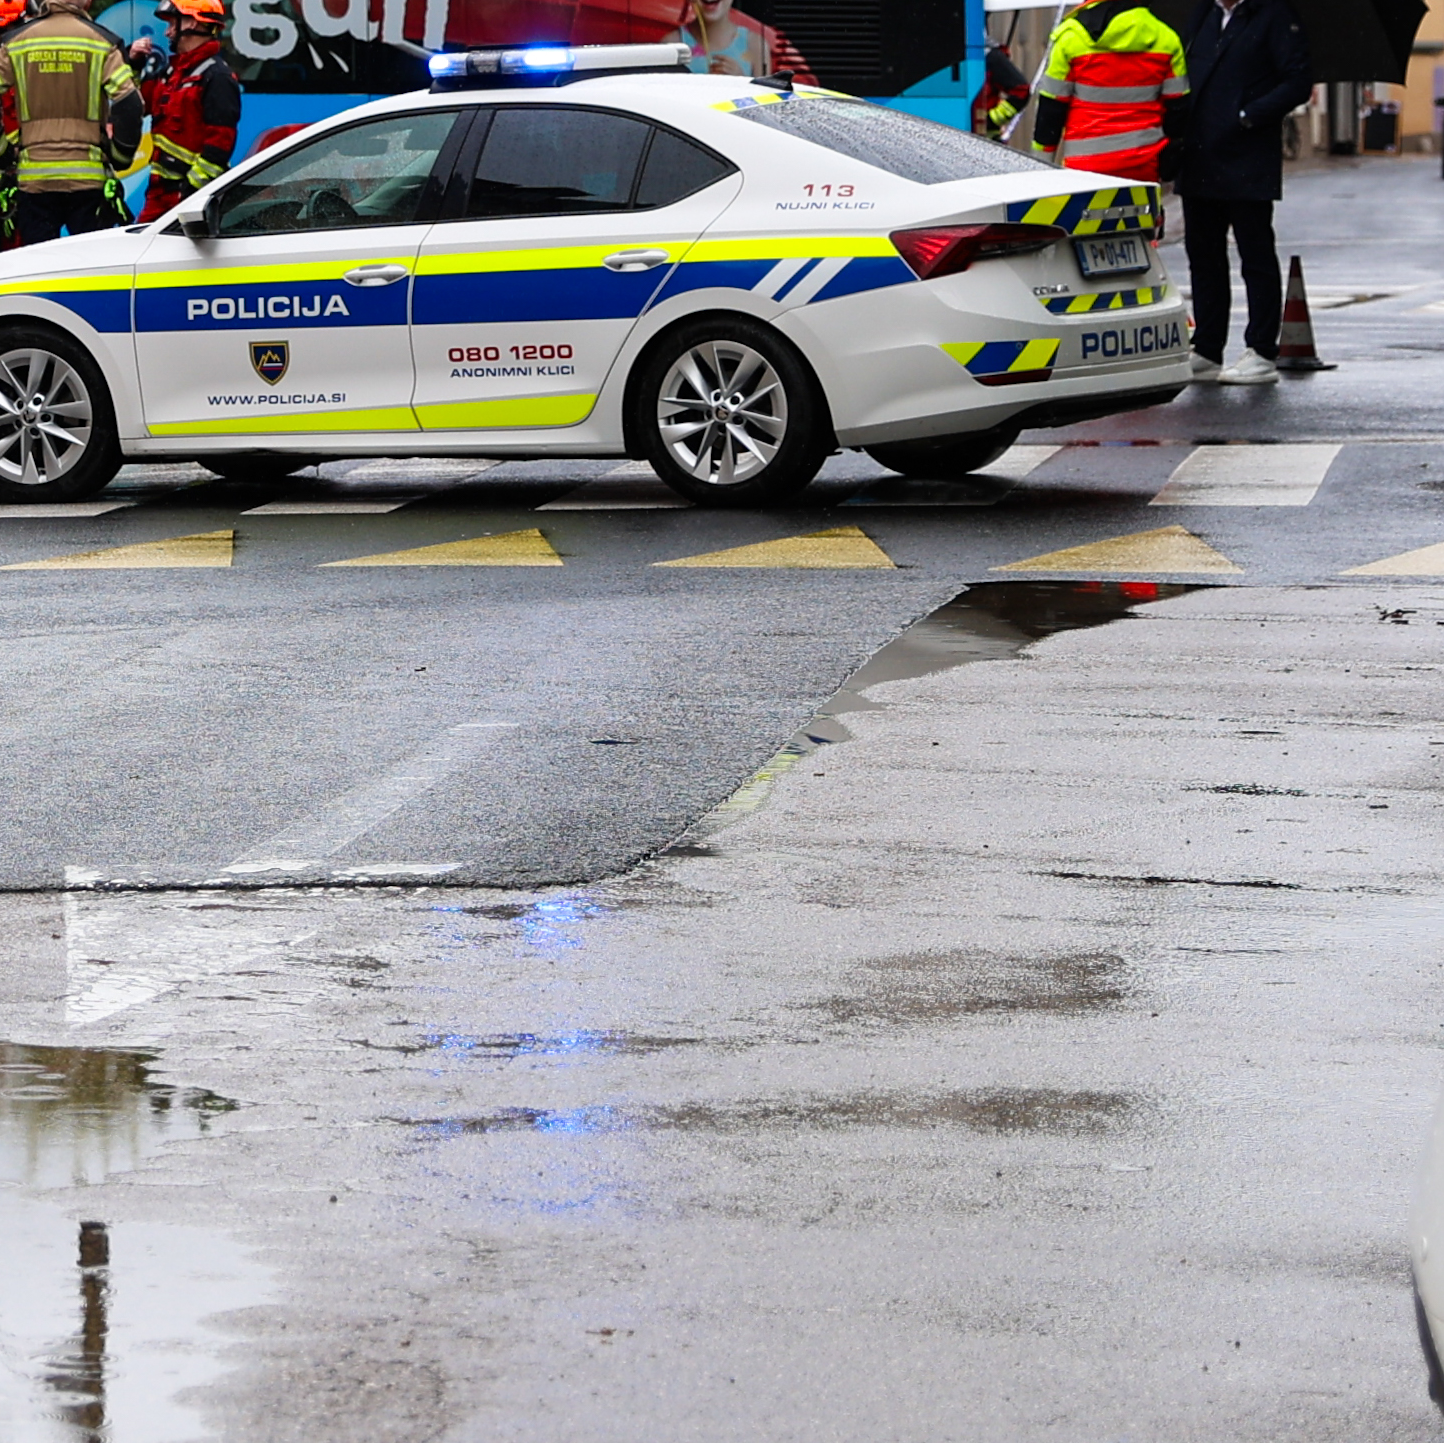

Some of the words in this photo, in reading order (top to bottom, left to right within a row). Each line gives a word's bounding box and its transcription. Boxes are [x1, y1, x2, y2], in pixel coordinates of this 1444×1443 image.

[803, 184, 856, 197] 113
[775, 202, 828, 211] NUJNI
[832, 202, 876, 210] KLICI
[1090, 243, 1100, 267] P
[187, 294, 351, 321] POLICIJA
[1080, 321, 1182, 360] POLICIJA
[447, 346, 500, 363] 080
[509, 344, 573, 361] 1200
[450, 366, 532, 378] ANONIMNI
[537, 365, 575, 376] KLICI
[207, 393, 347, 406] WWW.POLICIJA.SI
